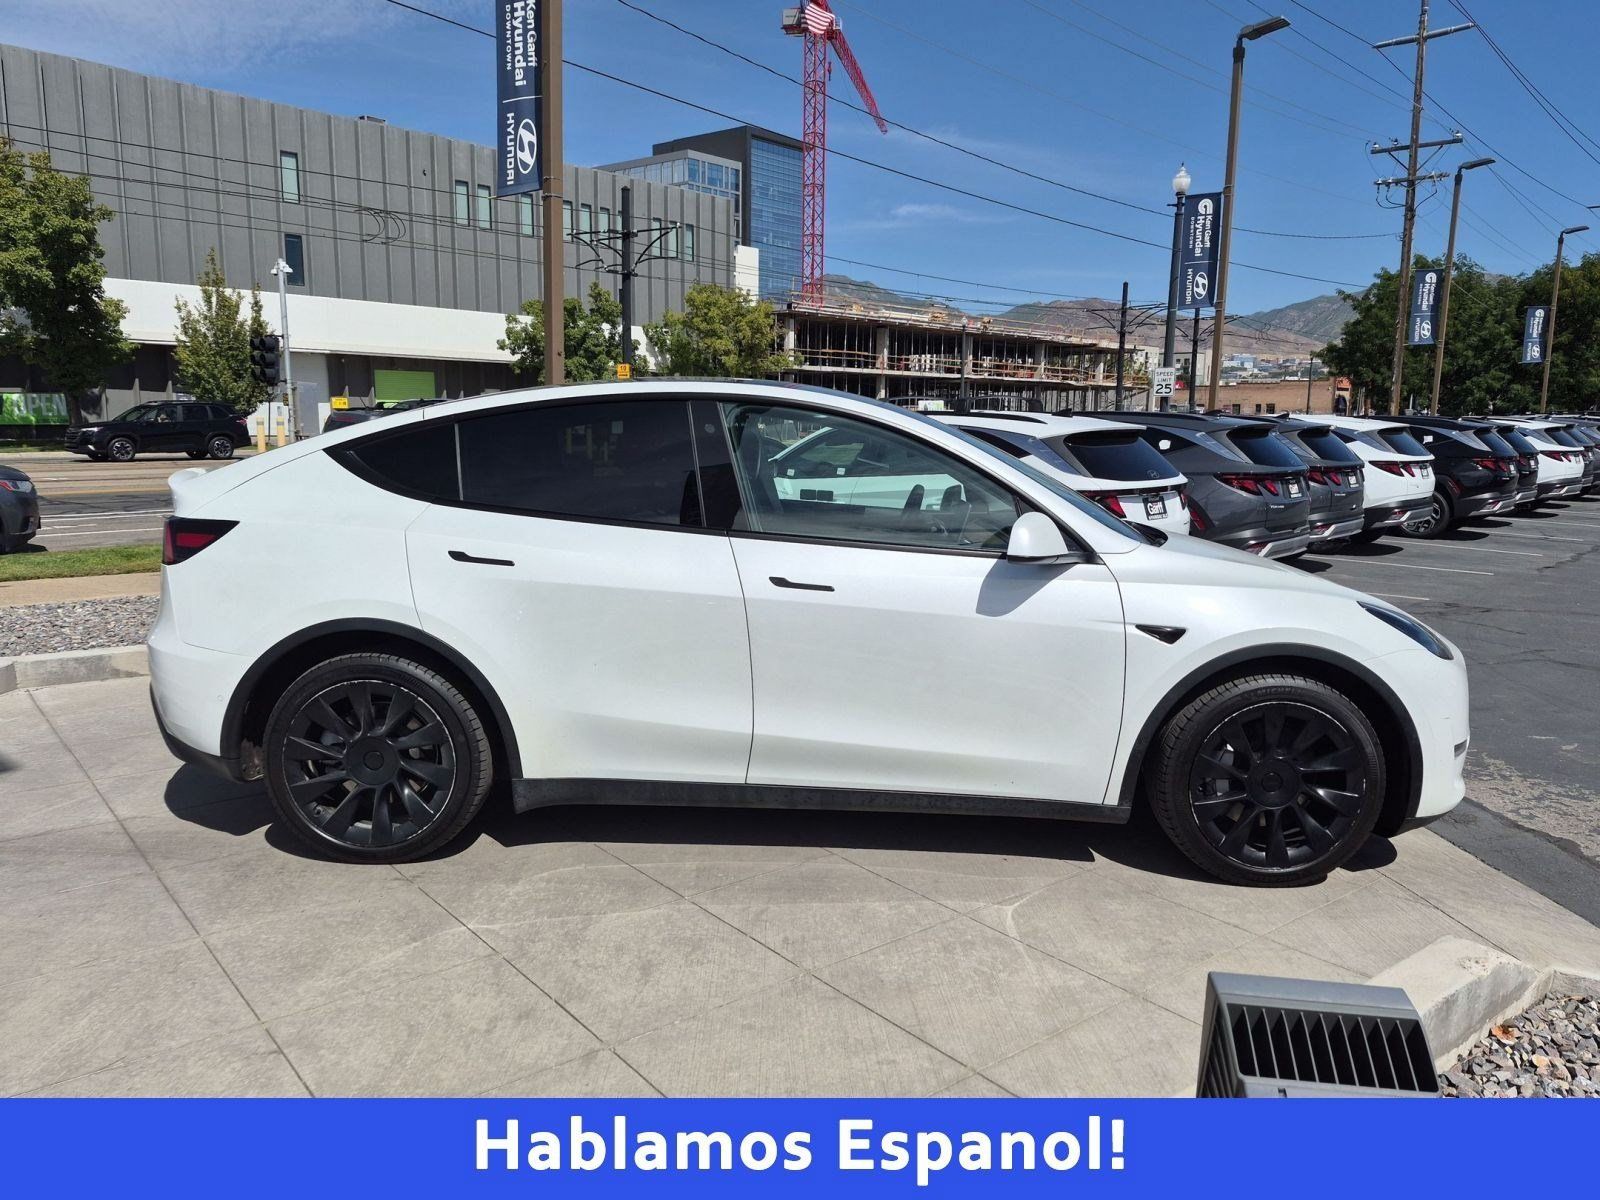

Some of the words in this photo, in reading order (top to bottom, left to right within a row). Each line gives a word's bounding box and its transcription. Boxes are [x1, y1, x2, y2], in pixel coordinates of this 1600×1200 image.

[526, 0, 536, 28] Ken
[512, 1, 527, 87] Hyundai
[527, 31, 538, 67] Garff
[506, 112, 515, 185] HYUNDAI
[1194, 215, 1204, 257] Hyundai
[1204, 215, 1213, 230] Ken
[1203, 230, 1212, 248] Garff
[1185, 268, 1193, 305] HYUNDAI
[1421, 283, 1430, 311] Hyundai
[1155, 383, 1172, 394] 25
